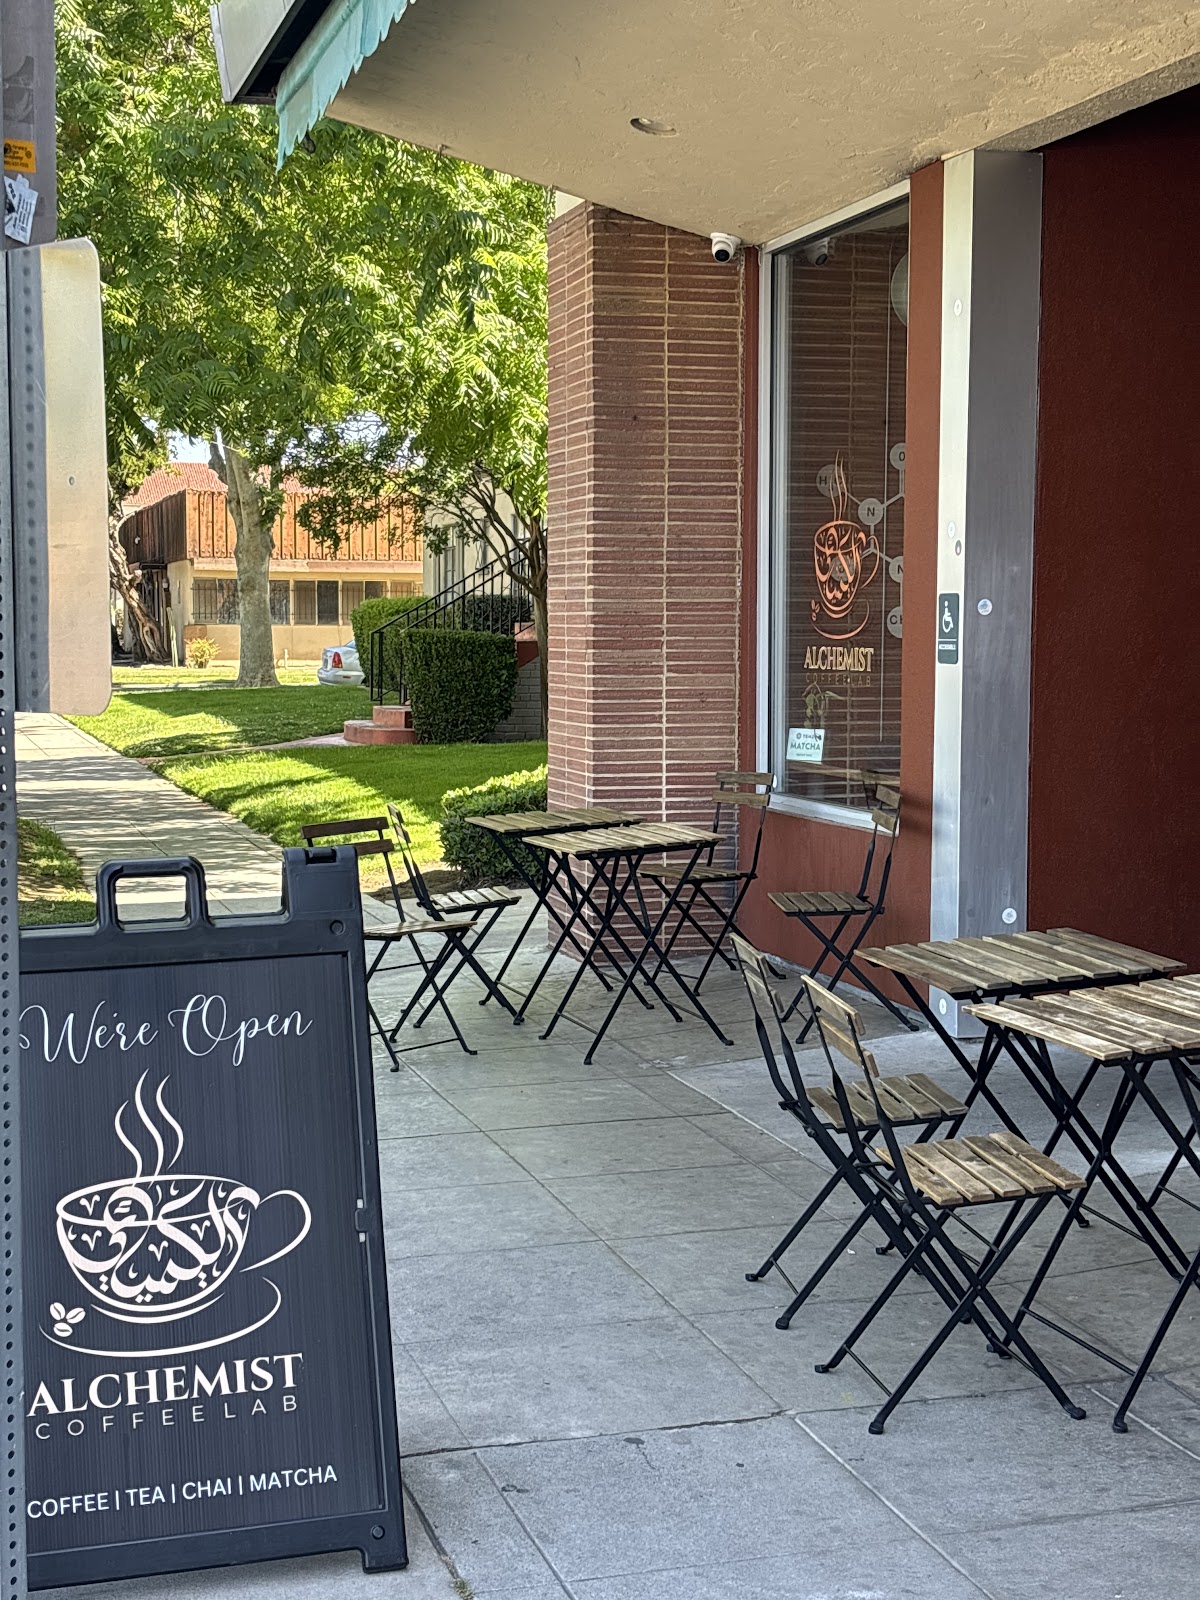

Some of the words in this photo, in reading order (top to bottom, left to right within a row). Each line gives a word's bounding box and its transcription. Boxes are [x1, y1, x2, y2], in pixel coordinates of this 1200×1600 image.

[803, 646, 875, 672] ALCHEMIST
[790, 742, 821, 751] MATCHA
[167, 994, 313, 1067] Open
[26, 1353, 303, 1417] ALCHEMIST
[27, 1492, 110, 1519] COFFEE
[125, 1486, 166, 1507] TEA
[182, 1477, 232, 1500] CHAI
[250, 1465, 338, 1492] MATCHA
